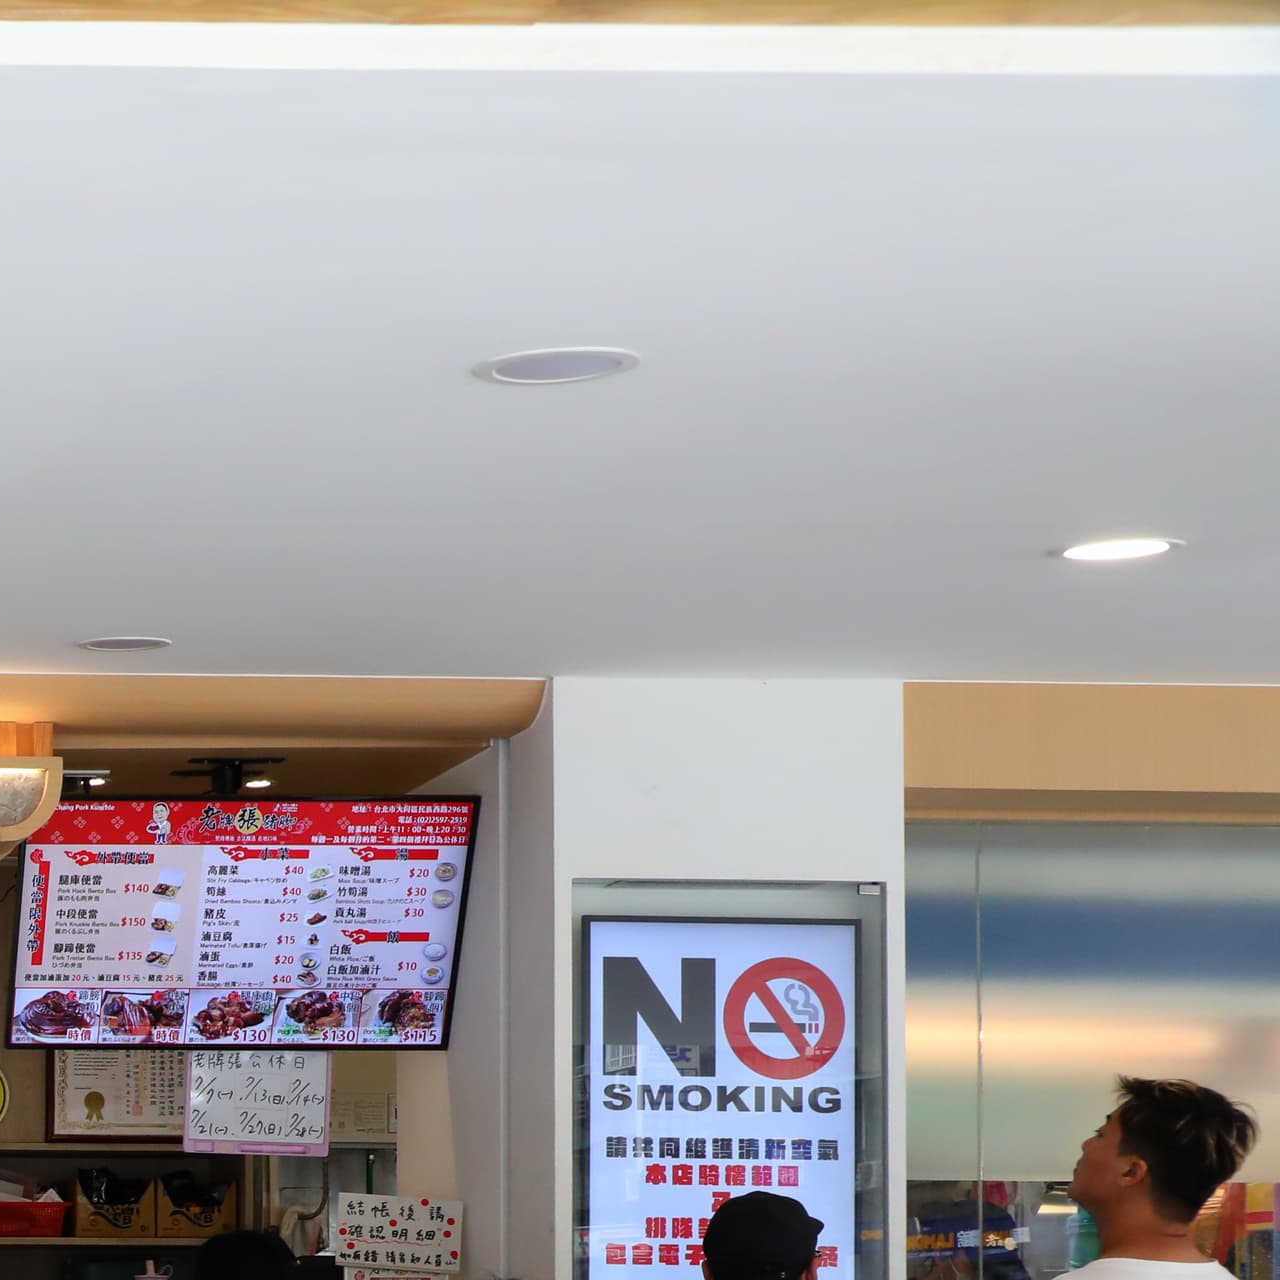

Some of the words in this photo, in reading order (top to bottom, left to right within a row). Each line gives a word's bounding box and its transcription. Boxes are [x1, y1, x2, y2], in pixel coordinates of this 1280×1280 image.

[97, 851, 151, 865] 外帶便當
[260, 847, 290, 861] 小菜
[207, 865, 239, 876] 高麗菜
[285, 866, 304, 875] $40
[409, 868, 430, 878] $20
[124, 883, 149, 894] $140
[206, 887, 227, 897] 筍絲
[282, 887, 302, 897] $40
[337, 887, 368, 897] 竹筍湯
[407, 887, 427, 897] $30
[26, 874, 45, 953] 便當限外帶
[55, 909, 98, 920] 中段便當
[204, 908, 226, 919] 豬皮
[280, 913, 298, 922] $25
[335, 907, 366, 918] 貢丸湯
[404, 908, 424, 918] $30
[121, 917, 146, 927] $150
[201, 931, 232, 942] 滷豆腐
[277, 935, 295, 945] $15
[330, 944, 351, 955] 白飯
[118, 951, 142, 961] $135
[275, 955, 294, 965] $20
[328, 965, 381, 975] 白飯加滷汁
[398, 962, 417, 971] $10
[273, 975, 291, 984] $40
[67, 1028, 93, 1041] 時價
[156, 1029, 180, 1041] 時價
[233, 1029, 267, 1042] $130
[322, 1029, 356, 1042] $130
[403, 1029, 437, 1042] $115
[602, 1083, 842, 1114] SMOKING
[606, 1136, 839, 1160] 請共同維護清新空氣
[646, 1163, 800, 1187] 本店騎樓範圍
[347, 1200, 445, 1222] 結帳後請
[348, 1224, 436, 1241] 確認明細
